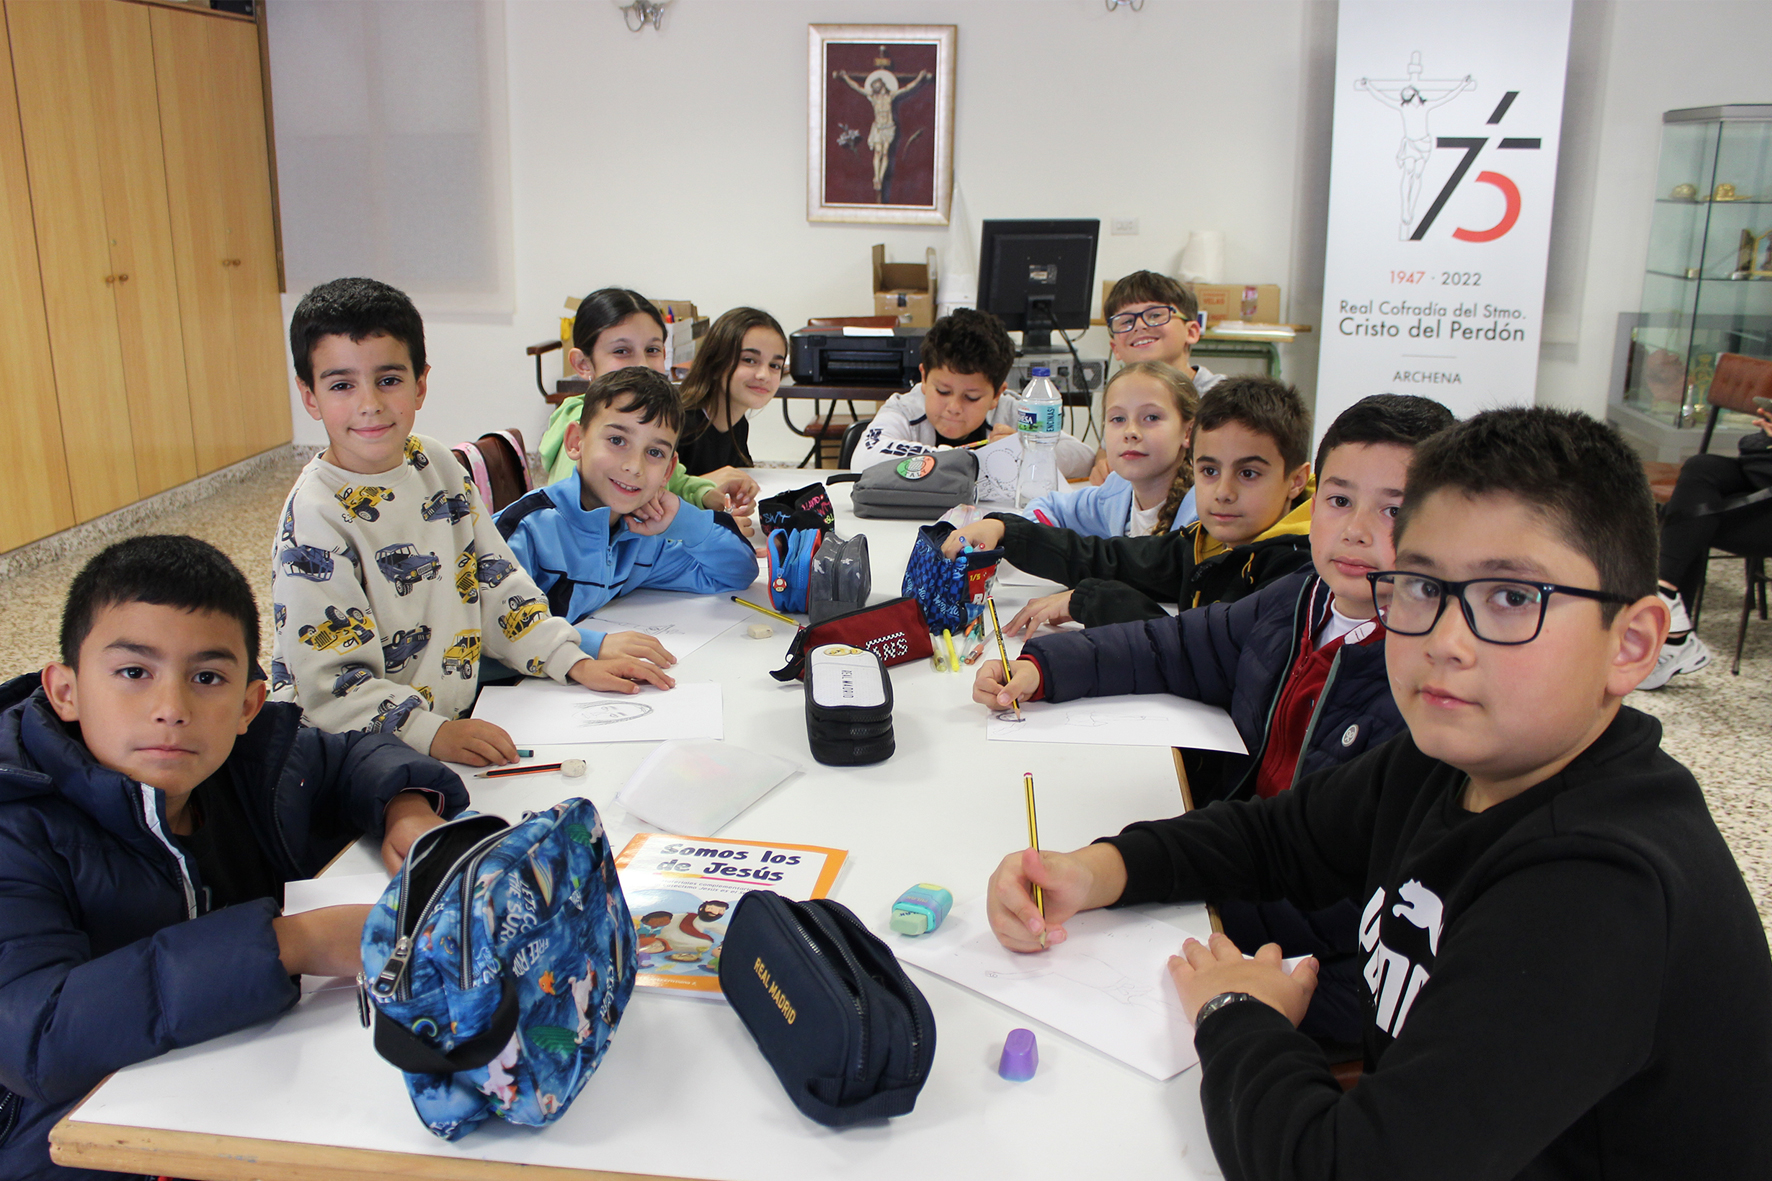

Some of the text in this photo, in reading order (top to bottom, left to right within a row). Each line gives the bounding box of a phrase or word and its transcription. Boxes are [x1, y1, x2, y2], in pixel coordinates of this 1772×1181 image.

[1390, 270, 1482, 286] 1947 2022
[1339, 300, 1526, 320] Real Cofradía del Stmo.
[1339, 316, 1525, 341] Cristo del Perdón
[1392, 370, 1463, 385] ARCHENA
[660, 843, 802, 865] Somos los
[656, 859, 785, 882] de Jesús
[753, 957, 796, 1025] REAL MADRID
